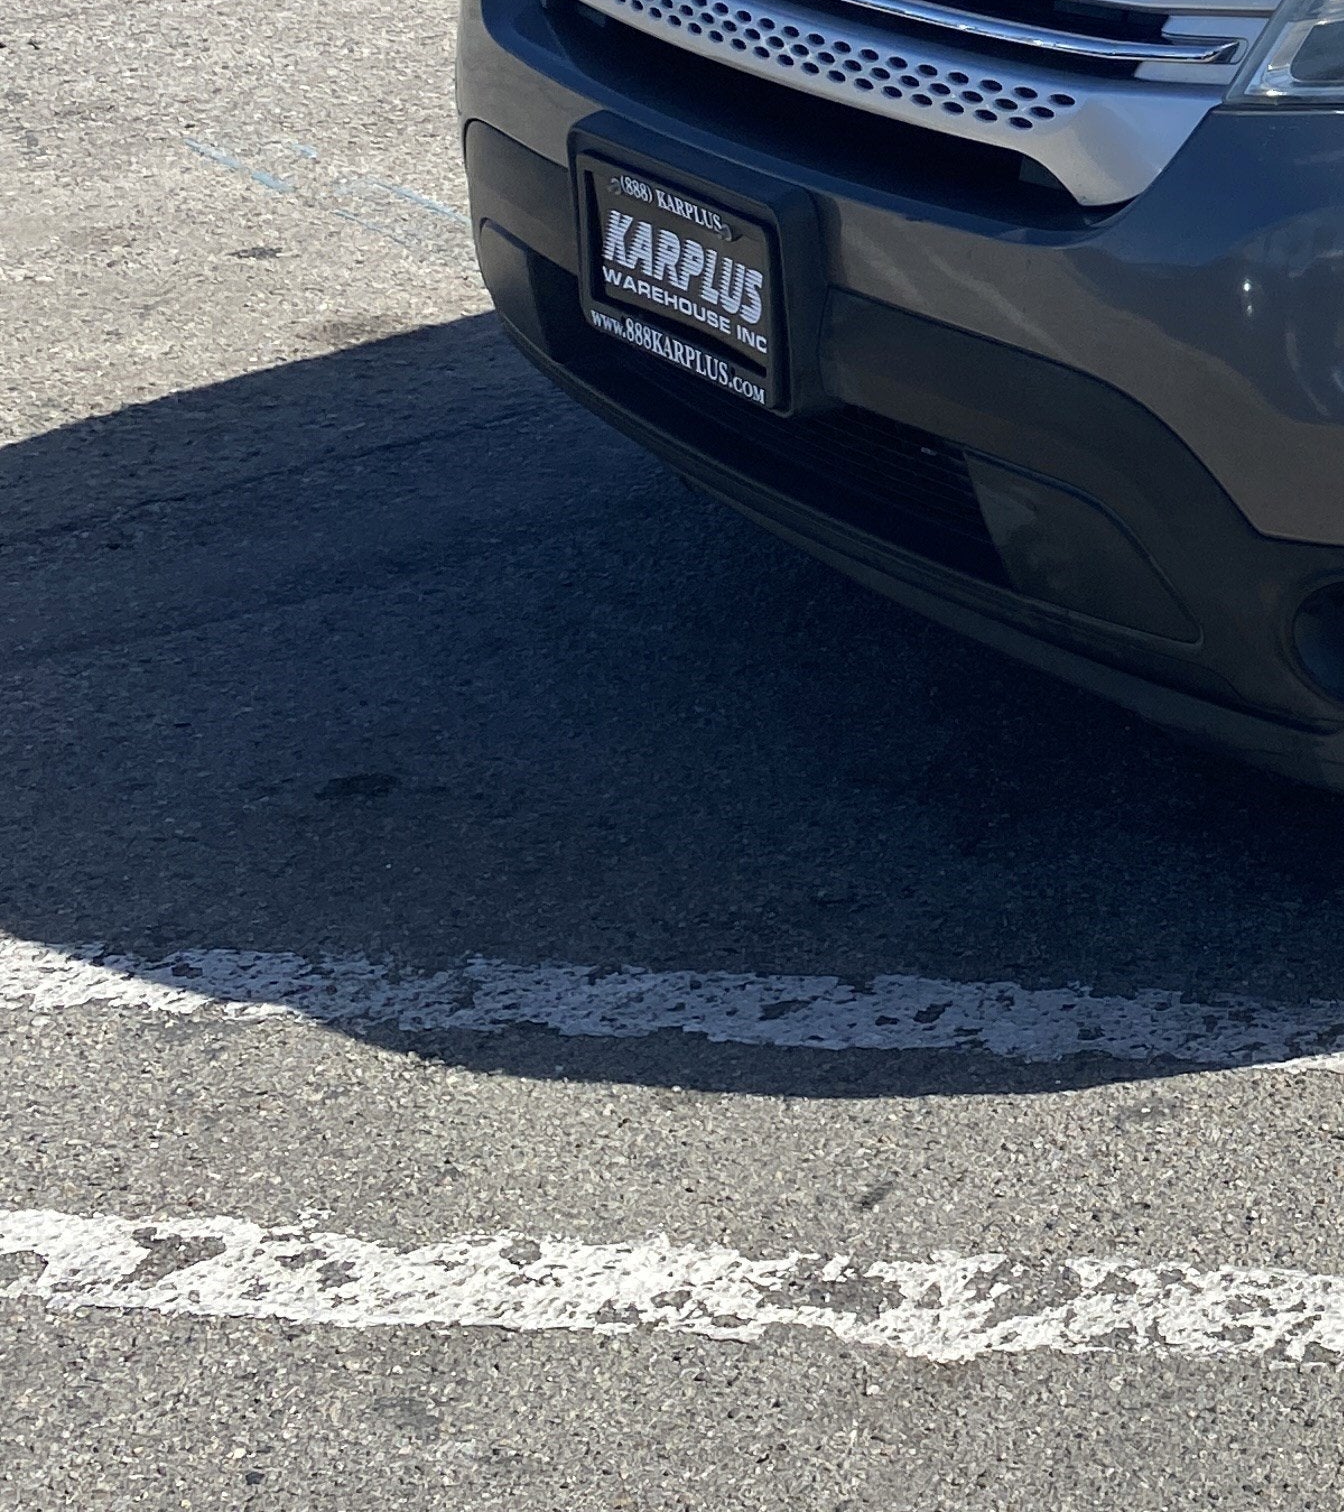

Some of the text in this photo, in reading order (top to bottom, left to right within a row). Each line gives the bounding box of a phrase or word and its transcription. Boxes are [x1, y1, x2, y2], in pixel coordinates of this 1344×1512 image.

[620, 175, 723, 229] (888) KARPLUS
[601, 209, 763, 324] KARPLUS
[602, 265, 768, 354] WAREHOUSE INC
